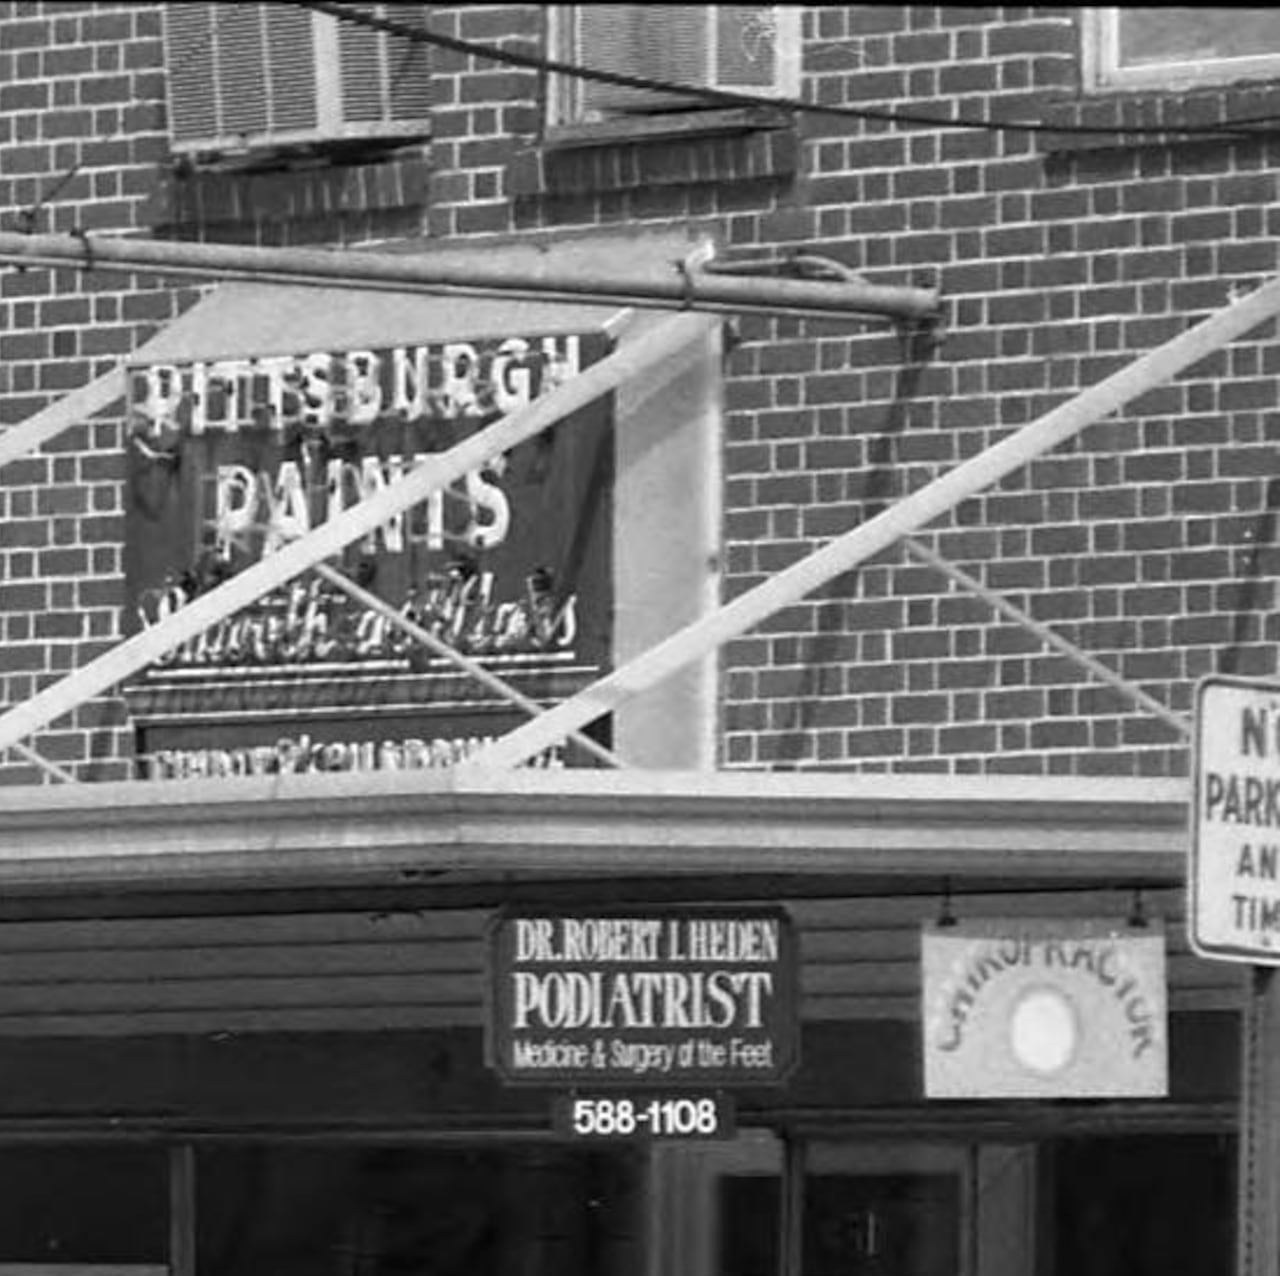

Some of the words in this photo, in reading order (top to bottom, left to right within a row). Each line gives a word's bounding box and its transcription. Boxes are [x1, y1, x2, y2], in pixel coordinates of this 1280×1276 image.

[144, 335, 581, 434] PITTSBURGH
[214, 455, 510, 560] PAINTS
[1240, 707, 1280, 756] N
[1236, 843, 1278, 879] AN
[516, 918, 561, 961] DR.
[562, 918, 662, 961] ROBERT
[512, 971, 774, 1029] PODIATRIST
[514, 1039, 589, 1070] Medicine
[591, 1037, 608, 1070] &
[610, 1039, 675, 1074] Surgery
[677, 1038, 695, 1068] of
[697, 1039, 727, 1068] the
[730, 1038, 775, 1069] Feet
[572, 1098, 718, 1136] 588-1108
